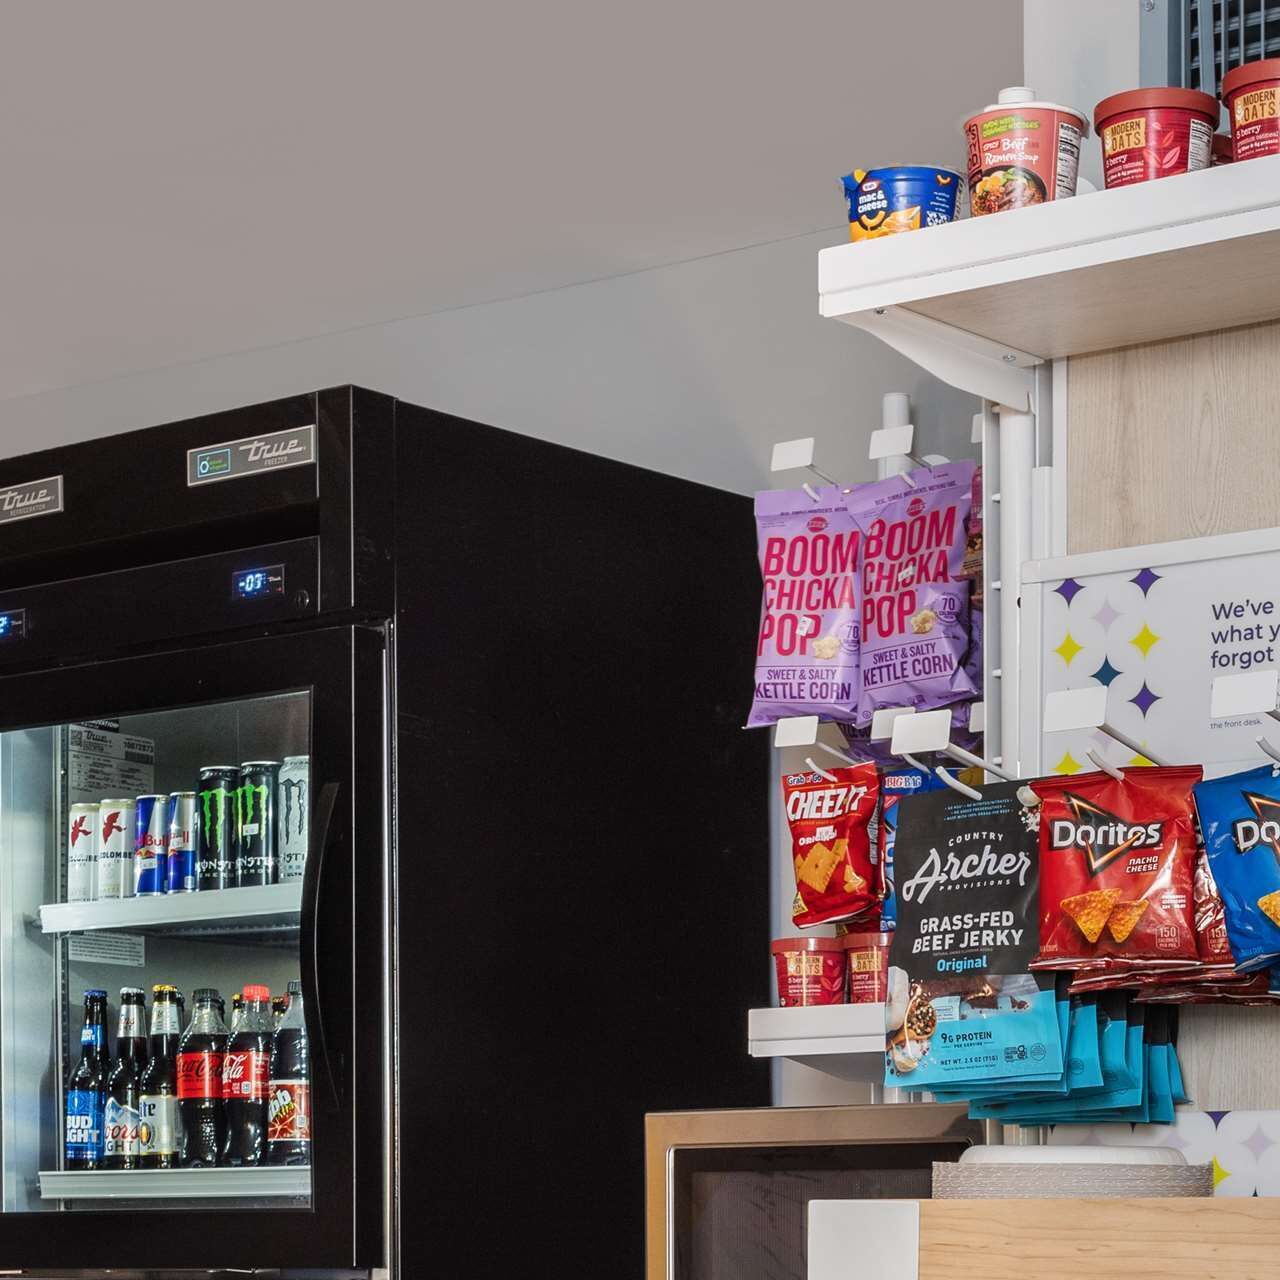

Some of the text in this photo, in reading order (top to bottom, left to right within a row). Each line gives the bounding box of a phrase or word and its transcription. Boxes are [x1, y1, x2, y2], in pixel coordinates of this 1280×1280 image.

[1242, 90, 1275, 105] MODERN
[1244, 102, 1276, 122] OATS
[1111, 120, 1141, 136] MODERN
[1240, 124, 1261, 137] berry
[1001, 137, 1029, 151] Beef
[1111, 132, 1141, 151] OATS
[1018, 152, 1039, 164] Soup
[876, 190, 885, 201] &
[863, 506, 956, 561] BOOM
[764, 530, 860, 577] BOOM
[863, 550, 949, 595] CHICKA
[763, 576, 856, 611] CHICKA
[943, 597, 955, 611] 70
[1211, 599, 1274, 621] We've
[862, 590, 916, 643] POP
[757, 613, 822, 657] POP
[1211, 622, 1263, 645] what
[872, 643, 935, 665] SWEET & SALTY
[1210, 647, 1274, 669] forgot
[767, 668, 837, 680] SWEET & SALTY
[863, 653, 954, 687] KETTLE CORN
[755, 682, 851, 701] KETTLE CORN
[1210, 717, 1263, 730] the front desk.
[787, 775, 805, 785] Grab
[885, 776, 902, 788] BIG
[949, 831, 1004, 847] COUNTRY
[1052, 820, 1161, 848] Doritos
[1126, 863, 1158, 873] CHEESE
[1129, 856, 1158, 866] NACHO
[901, 845, 1031, 905] Archer
[939, 879, 1011, 891] PROVISIONS
[919, 910, 1015, 933] GRASS-FED
[912, 929, 1024, 954] BEEF JERKY
[1160, 927, 1176, 938] 150
[936, 955, 988, 974] Original
[940, 1031, 992, 1044] 9G PROTEIN
